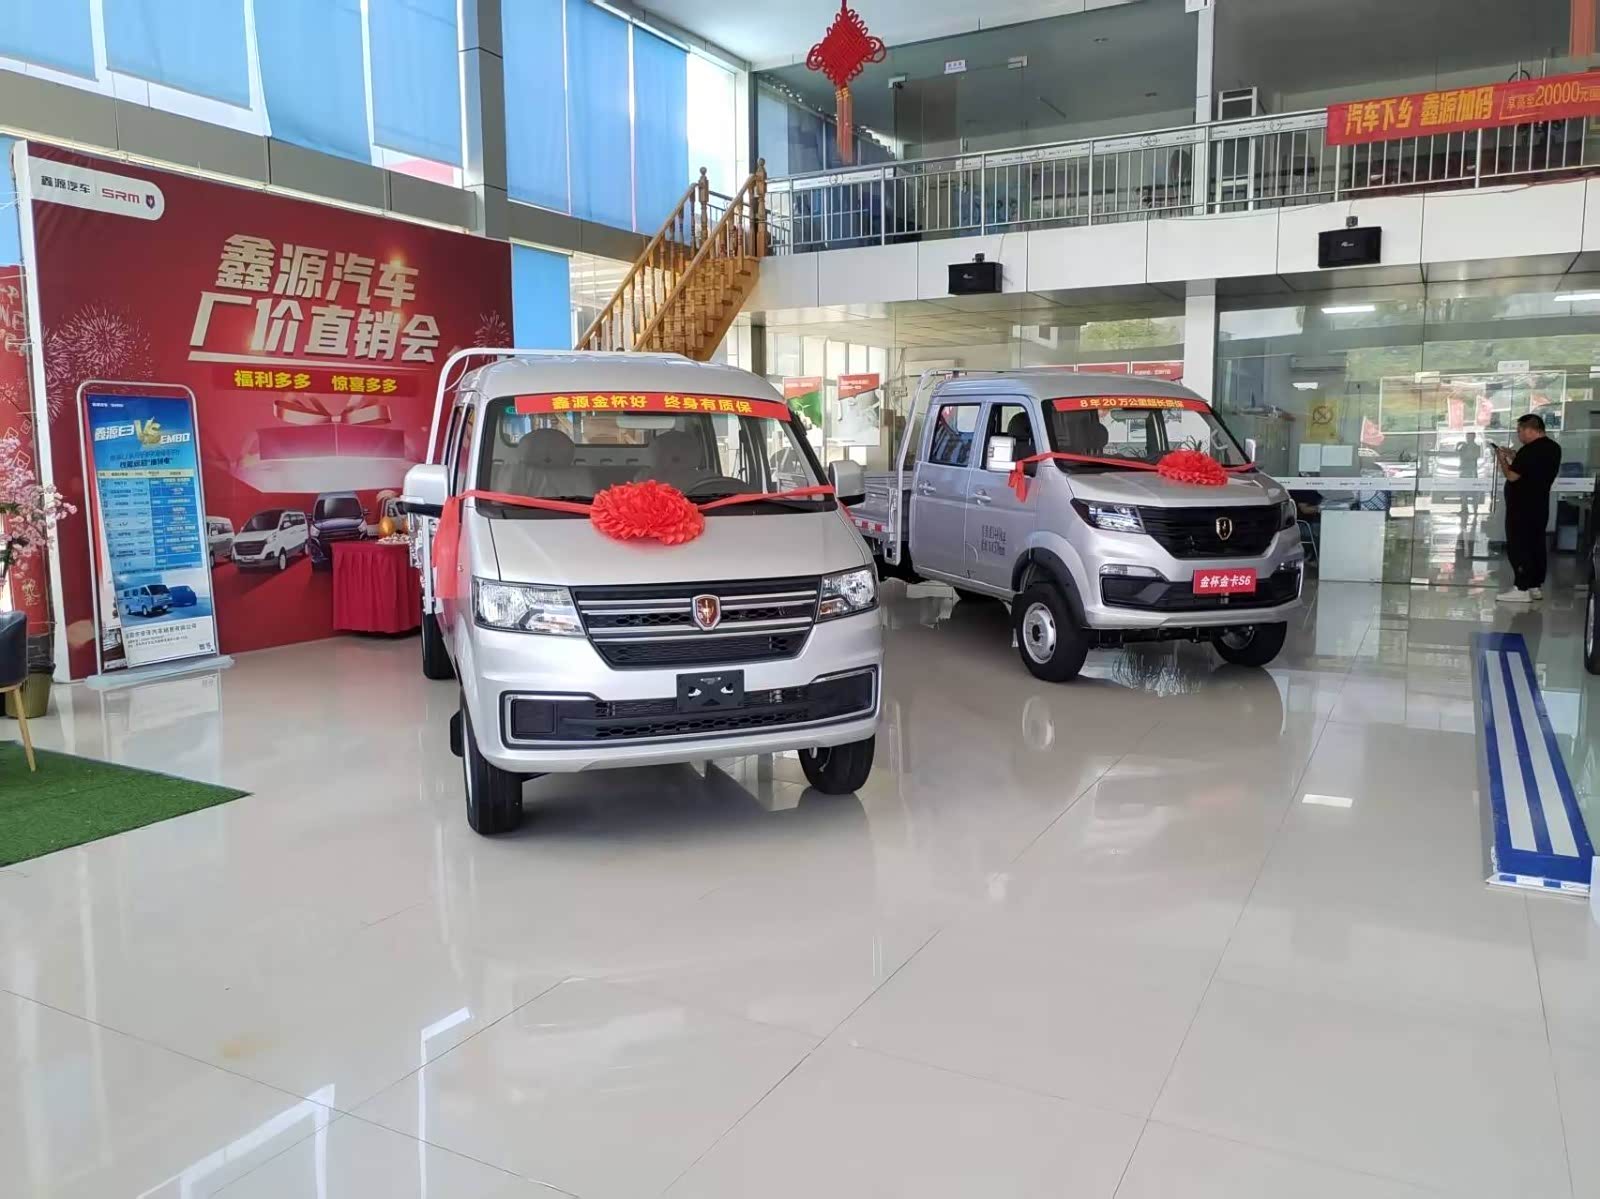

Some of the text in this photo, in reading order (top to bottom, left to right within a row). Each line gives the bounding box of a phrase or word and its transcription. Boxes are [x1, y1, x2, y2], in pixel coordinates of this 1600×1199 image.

[1344, 96, 1413, 136] 汽车下乡
[1419, 86, 1495, 127] 鑫源加码
[41, 175, 91, 194] 鑫源汽车
[215, 233, 419, 308] 鑫源汽车
[189, 290, 441, 363] 厂价直销会
[233, 369, 398, 393] 福利多多 惊喜多多
[551, 394, 752, 413] 鑫源金杯好 终身有质保
[1199, 574, 1252, 589] 金杯金卡S6
